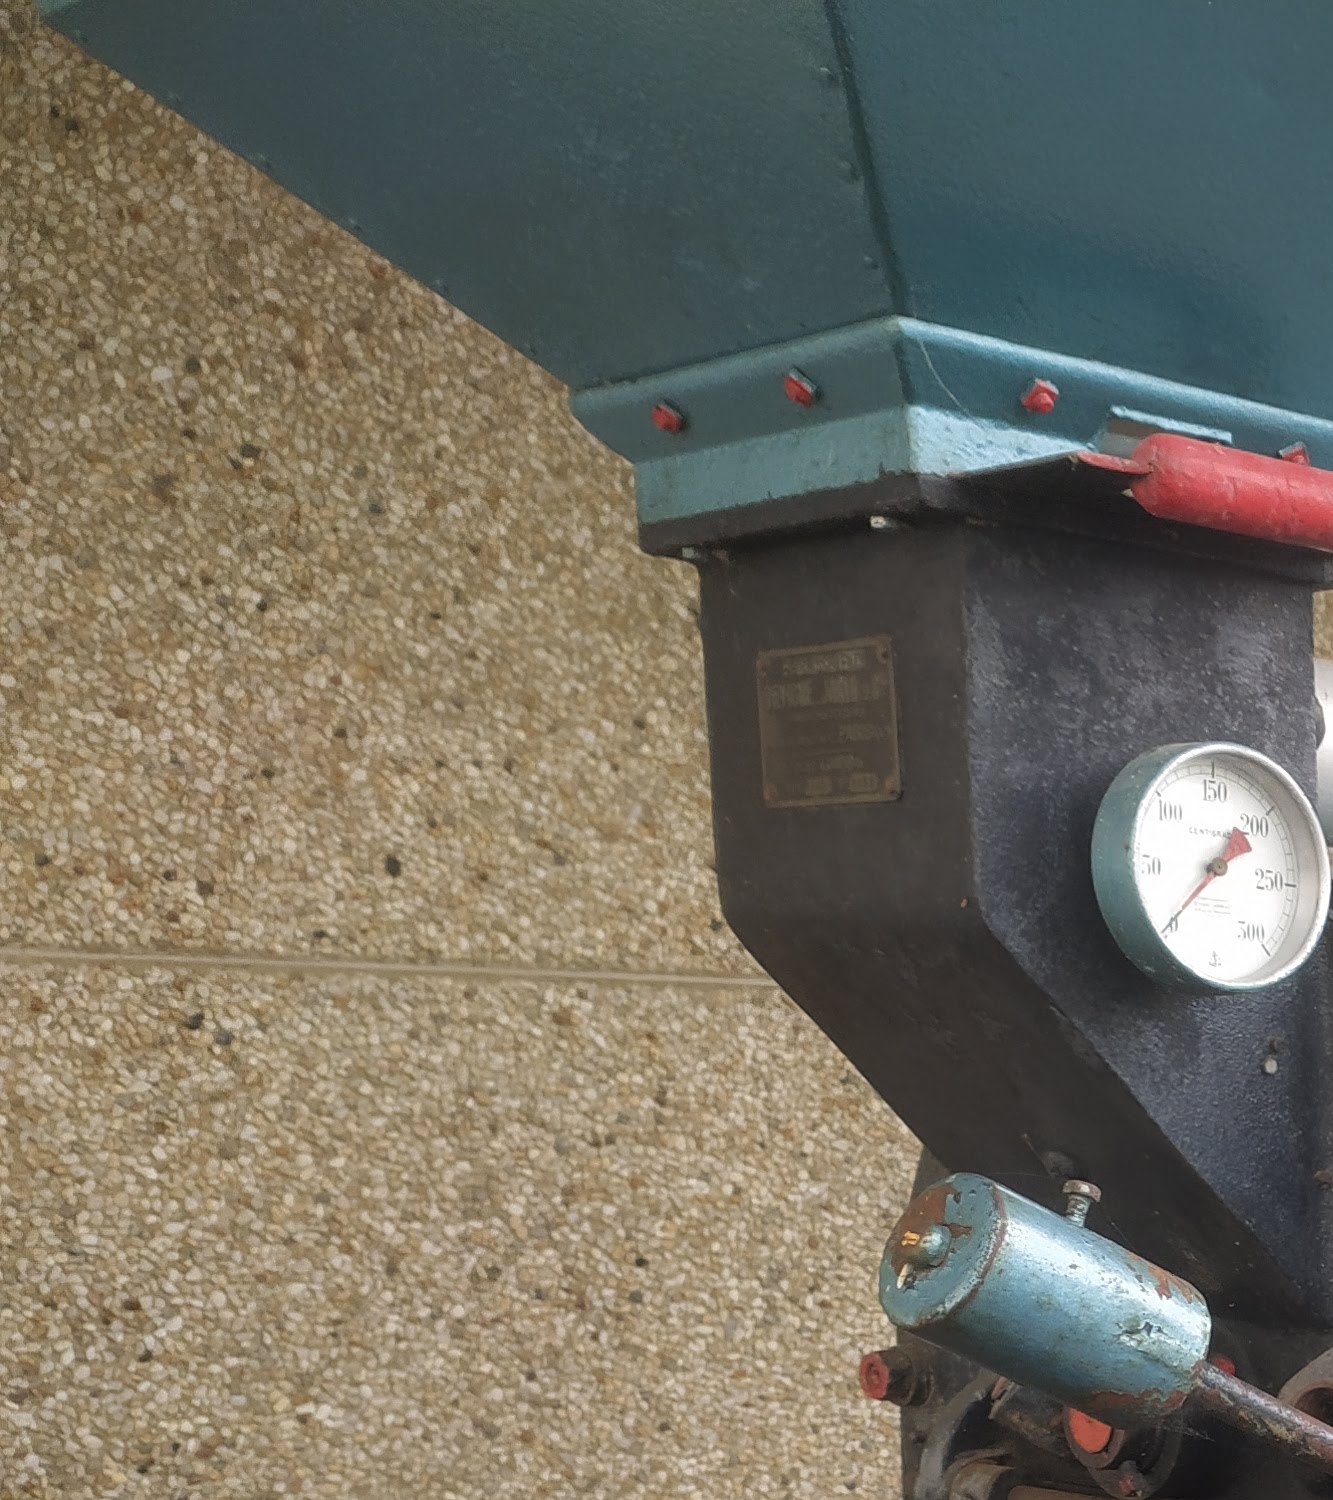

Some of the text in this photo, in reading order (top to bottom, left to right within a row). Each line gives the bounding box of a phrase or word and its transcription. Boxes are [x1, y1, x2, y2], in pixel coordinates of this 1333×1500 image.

[1202, 779, 1227, 803] 150
[1159, 798, 1183, 822] 100
[1240, 812, 1269, 838] 200
[1141, 853, 1161, 876] 50
[1254, 868, 1283, 891] 250
